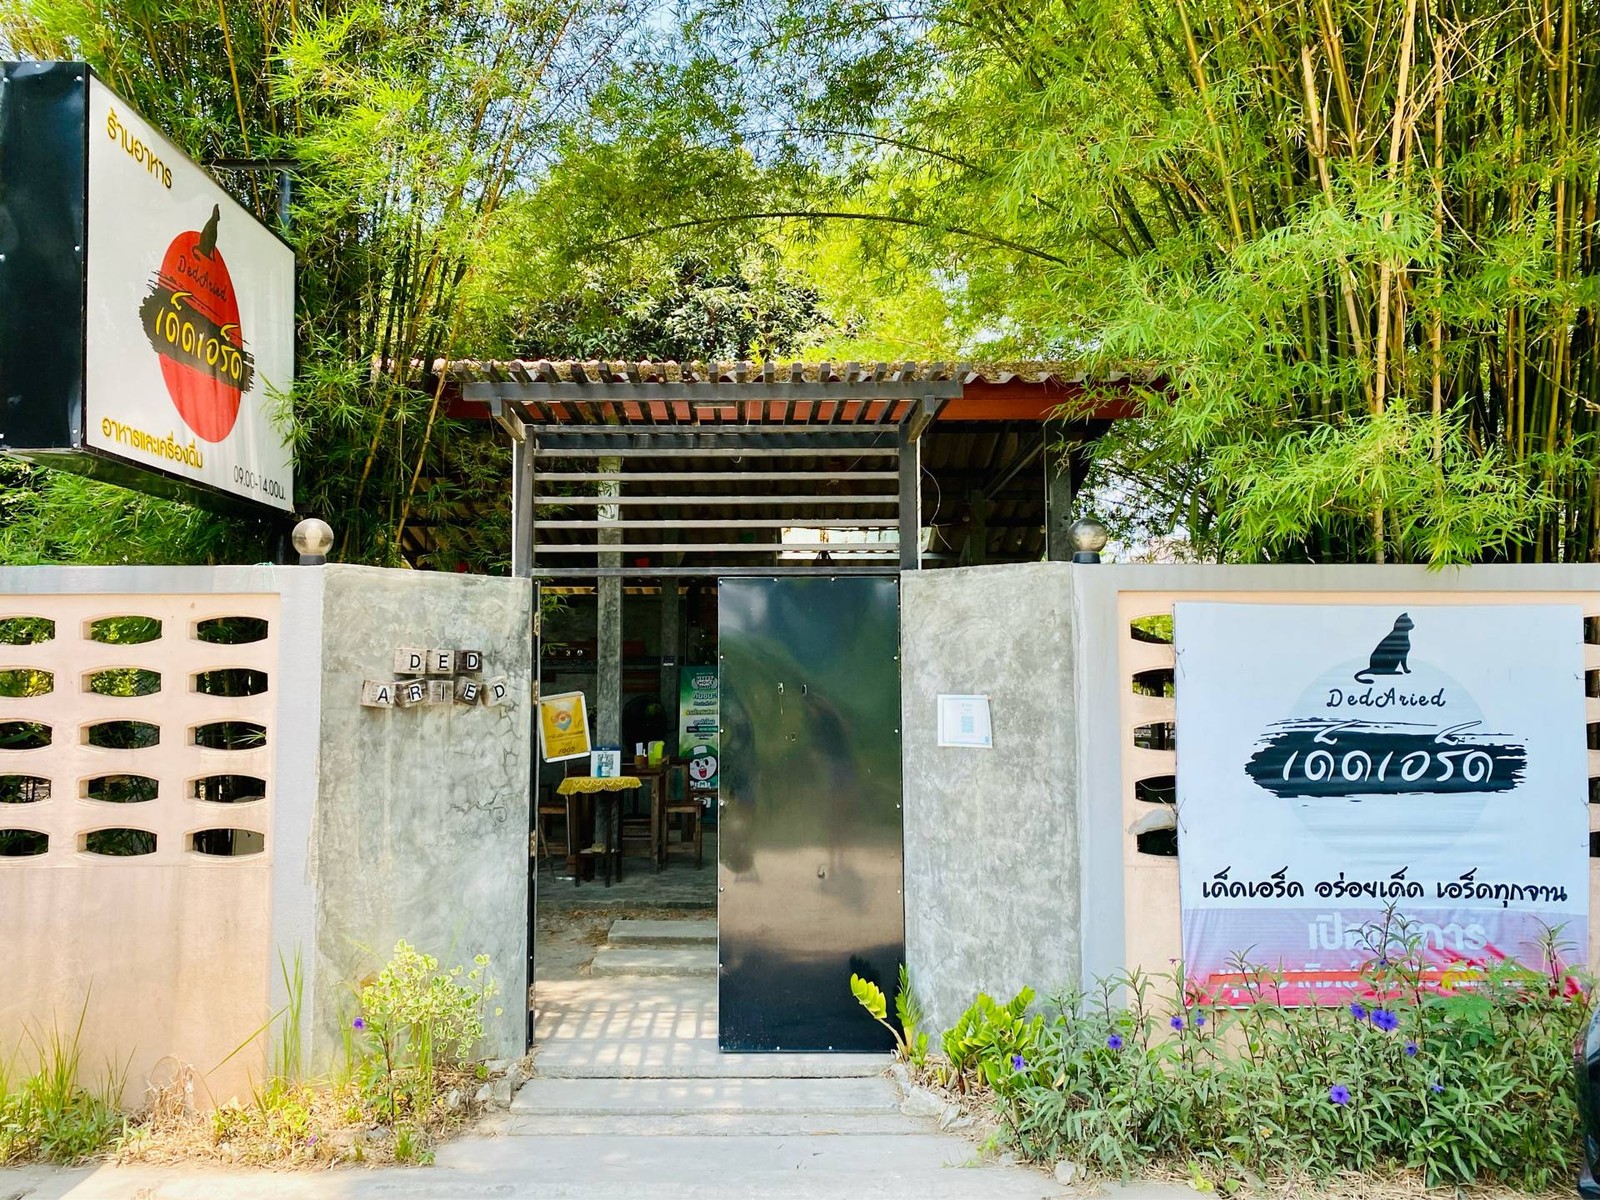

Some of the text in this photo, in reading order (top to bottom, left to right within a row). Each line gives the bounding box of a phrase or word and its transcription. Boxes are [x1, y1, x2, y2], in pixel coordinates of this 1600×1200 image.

[107, 107, 172, 189] ร้านอาหาร
[178, 254, 227, 302] DedAried
[155, 291, 243, 382] เด็ดเอร็ด
[102, 416, 204, 469] อาหารและเครื่องดื่ม
[410, 653, 478, 671] DED
[377, 683, 505, 704] ARIED
[1326, 687, 1447, 708] DedAried
[1282, 719, 1494, 784] เด็ดเอร็ด
[1202, 866, 1568, 908] เด็ดเอร็ด อร่อยเด็ด เอร็ดทุกจาน
